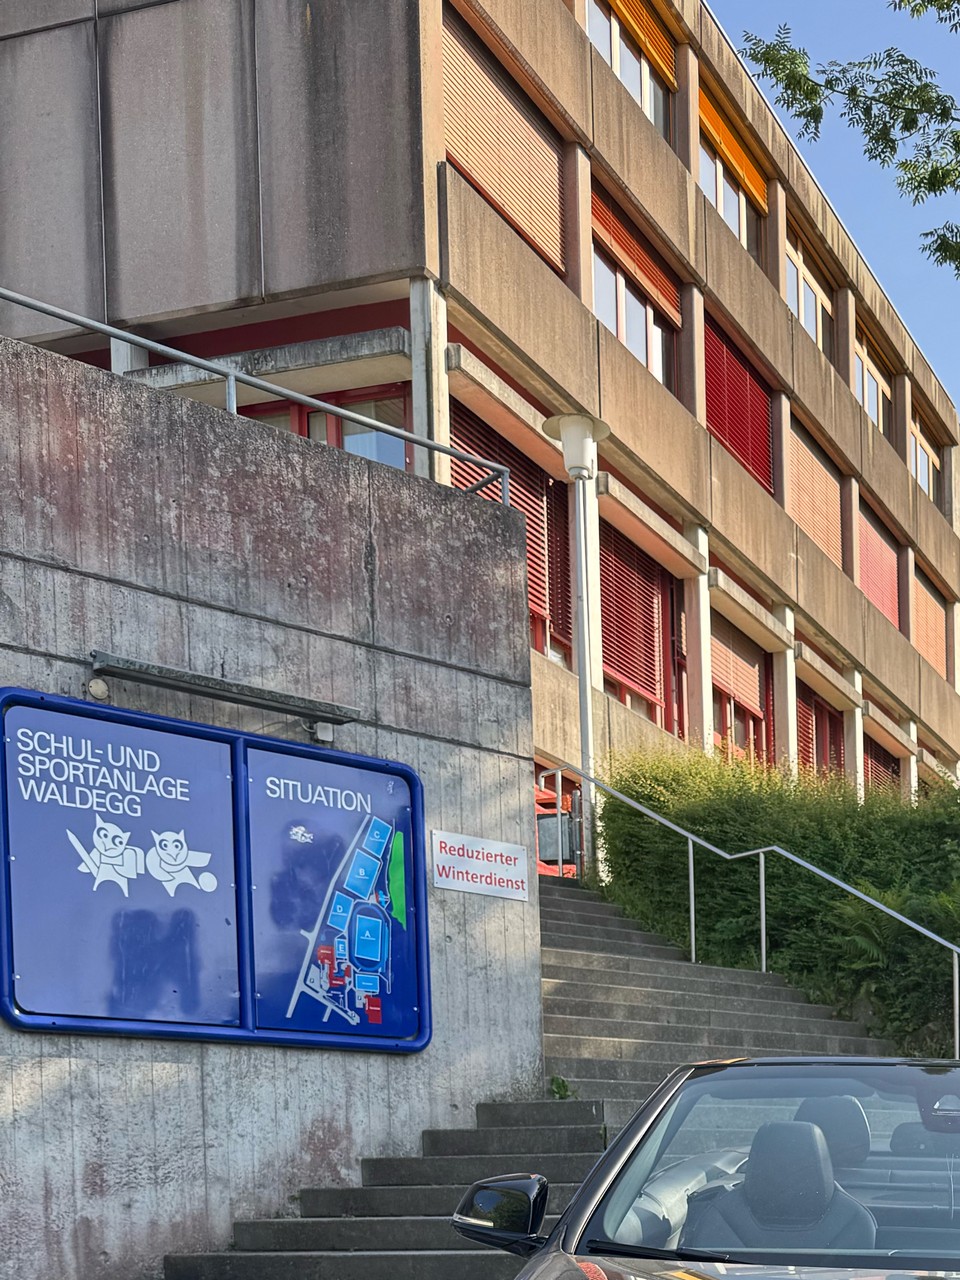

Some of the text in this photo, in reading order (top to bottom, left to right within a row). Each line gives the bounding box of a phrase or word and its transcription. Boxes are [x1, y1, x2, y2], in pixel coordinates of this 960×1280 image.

[16, 728, 161, 772] SCHUL- UND
[17, 753, 191, 801] SPORTANLAGE
[265, 776, 372, 814] SITUATION
[17, 777, 142, 817] WALDEGG
[438, 840, 519, 867] Reduzierter
[436, 863, 526, 891] Winterdienst
